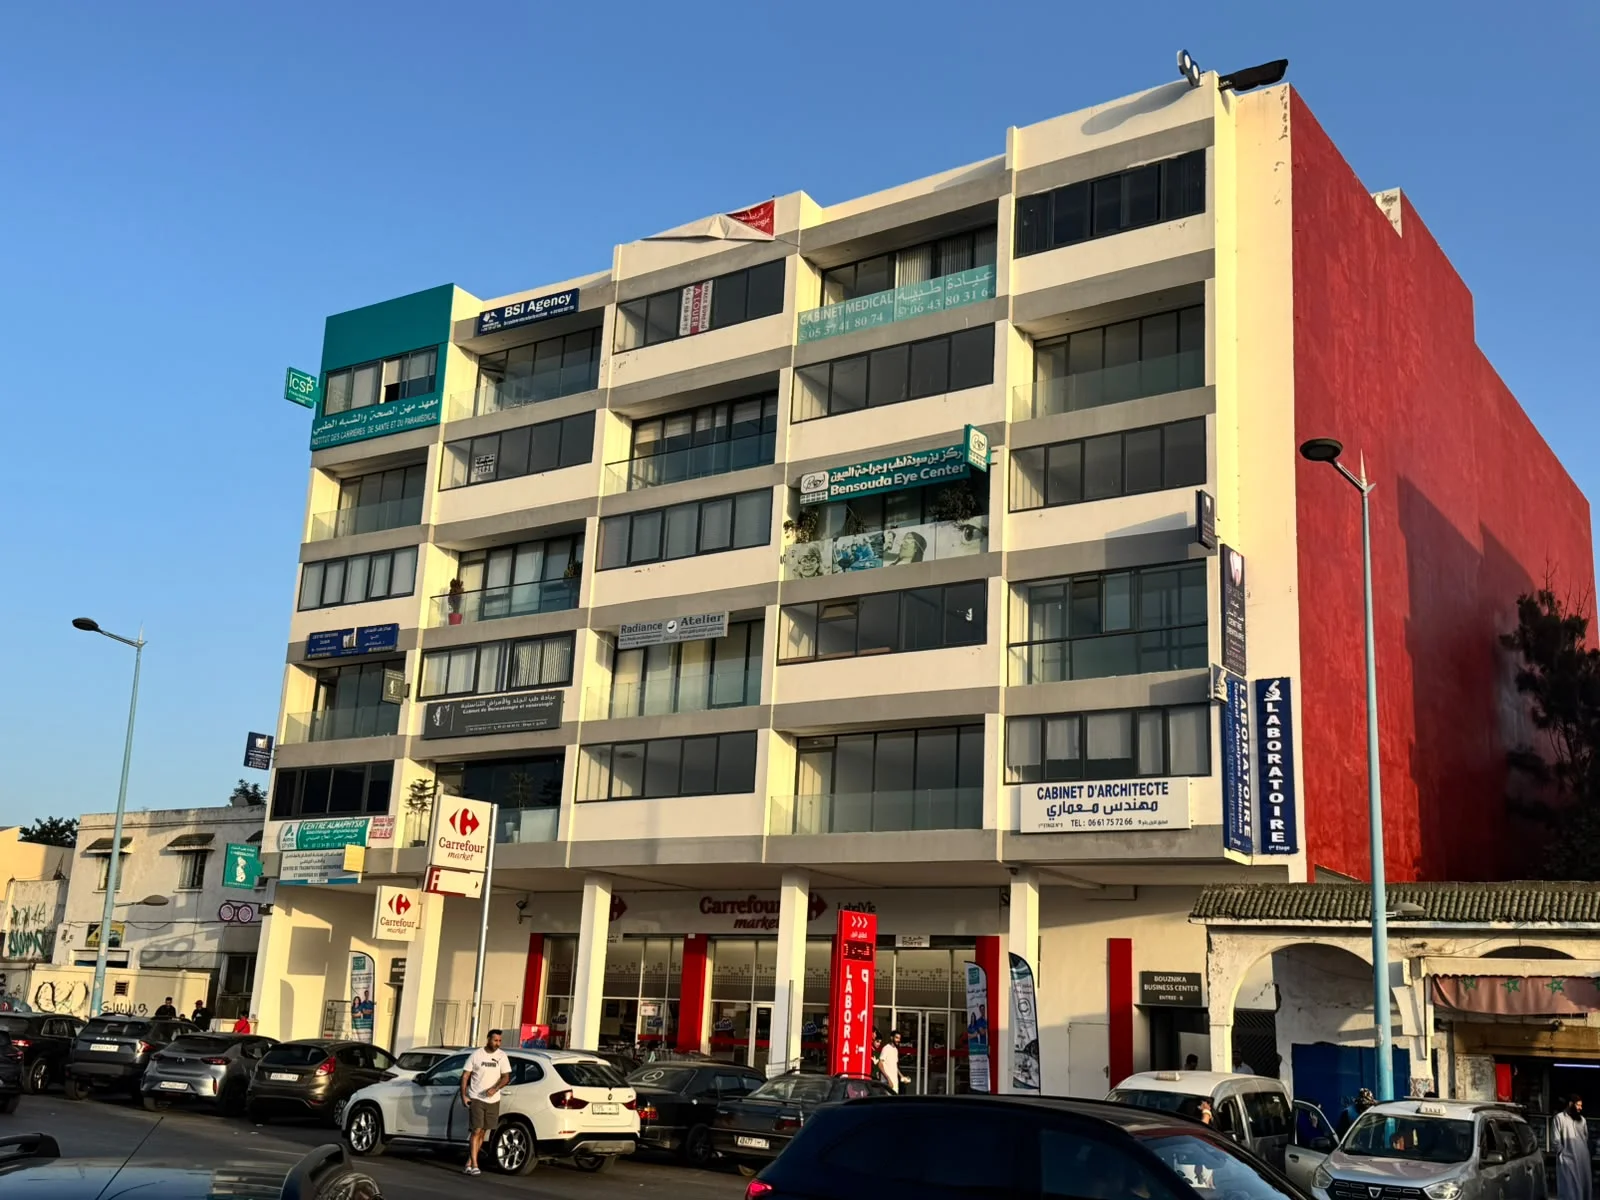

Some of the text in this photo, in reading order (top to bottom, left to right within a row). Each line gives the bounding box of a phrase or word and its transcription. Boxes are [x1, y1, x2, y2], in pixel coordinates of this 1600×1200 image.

[898, 270, 993, 301] عيادة طبية
[504, 303, 525, 318] BSI
[527, 293, 572, 312] Agency
[910, 303, 924, 314] 06
[927, 299, 942, 310] 43
[945, 294, 960, 306] 80
[962, 290, 977, 302] 31
[691, 297, 700, 327] LOUER
[800, 306, 844, 325] CABINET
[854, 316, 867, 328] 80
[871, 312, 883, 324] 74
[369, 407, 398, 421] الصحة
[940, 447, 963, 461] ركز
[830, 476, 892, 495] Bensouda
[894, 470, 918, 485] Eye
[920, 462, 966, 479] Center
[621, 614, 724, 634] Radiance Atelier
[1239, 684, 1251, 838] LABORATOIRE
[1265, 703, 1285, 843] LABORATOIRE
[1037, 782, 1169, 800] CABINET D'ARCHITECTE
[1047, 798, 1158, 821] مهندس معماري
[438, 836, 485, 854] Carrefour
[447, 851, 474, 861] market
[380, 917, 416, 928] Carrefour
[1144, 984, 1199, 992] BUSINESS CENTER
[1154, 975, 1187, 983] BOUZNIKA
[842, 965, 853, 1077] LABORAT
